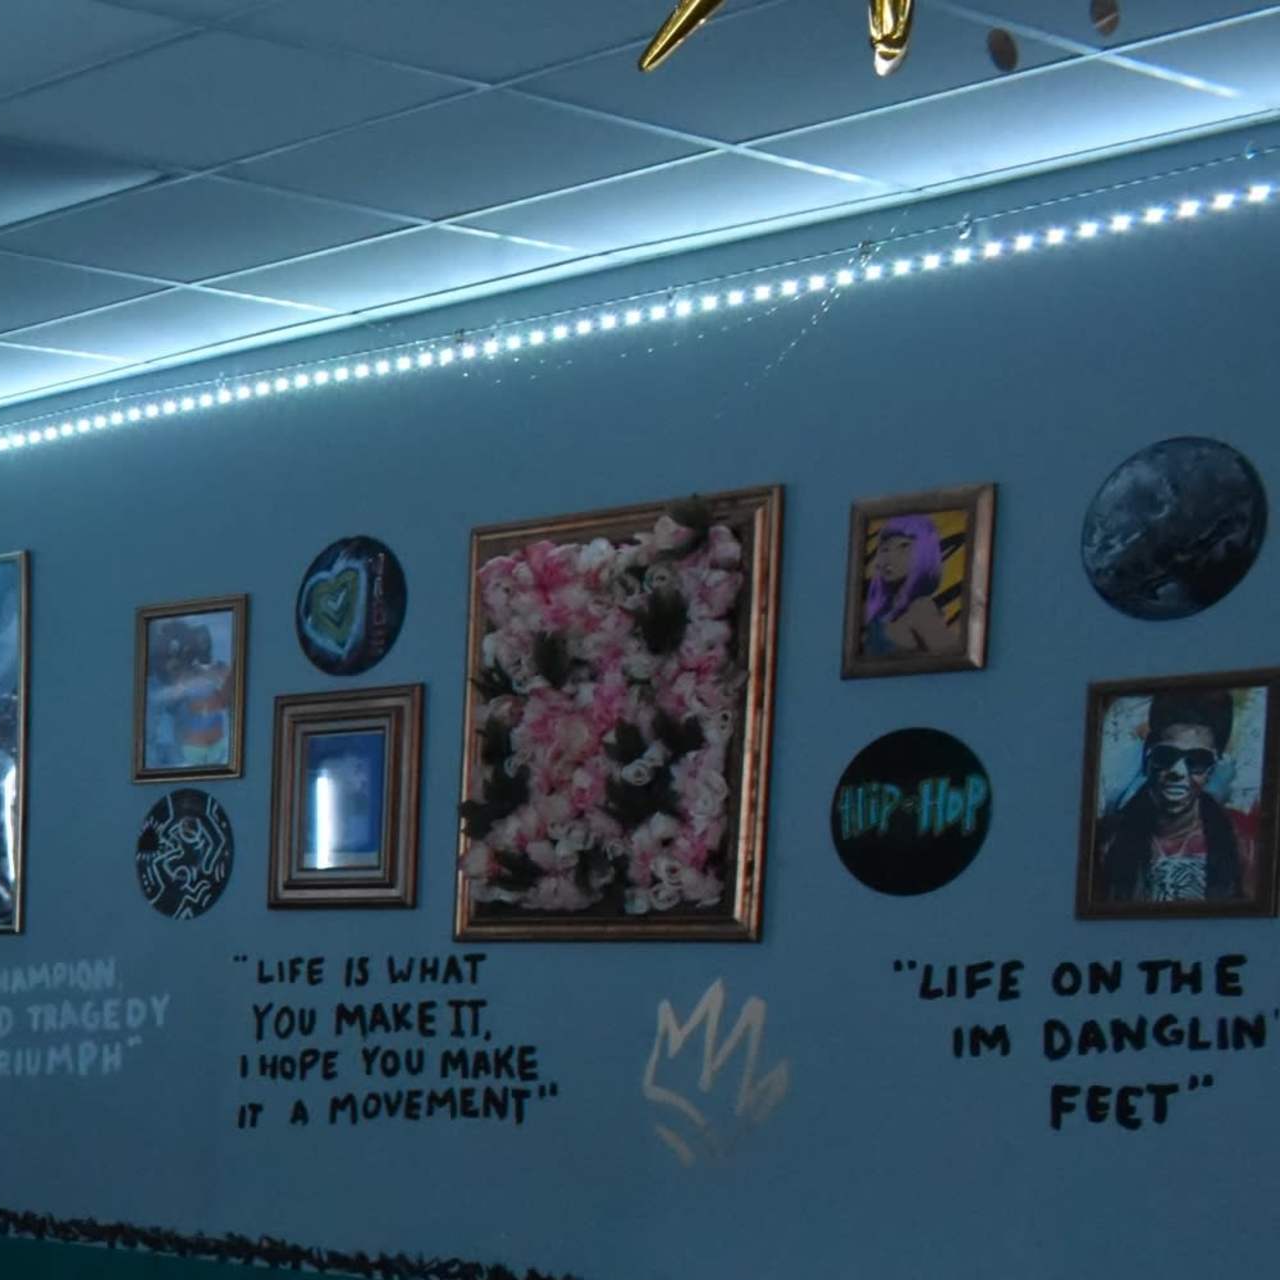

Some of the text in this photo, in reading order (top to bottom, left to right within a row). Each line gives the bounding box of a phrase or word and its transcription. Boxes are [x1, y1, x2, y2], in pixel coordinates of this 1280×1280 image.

[234, 953, 486, 987] "LIFE IS WHAT
[893, 954, 1247, 1001] "LIFE ON THE
[27, 993, 171, 1032] TRAGEDY
[253, 999, 491, 1041] YOU MAKE IT,
[953, 1025, 1010, 1058] IM
[241, 1045, 538, 1081] I HOPE YOU MAKE
[238, 1082, 558, 1129] IT A MOVEMENT"
[1049, 1074, 1214, 1131] FEET"
